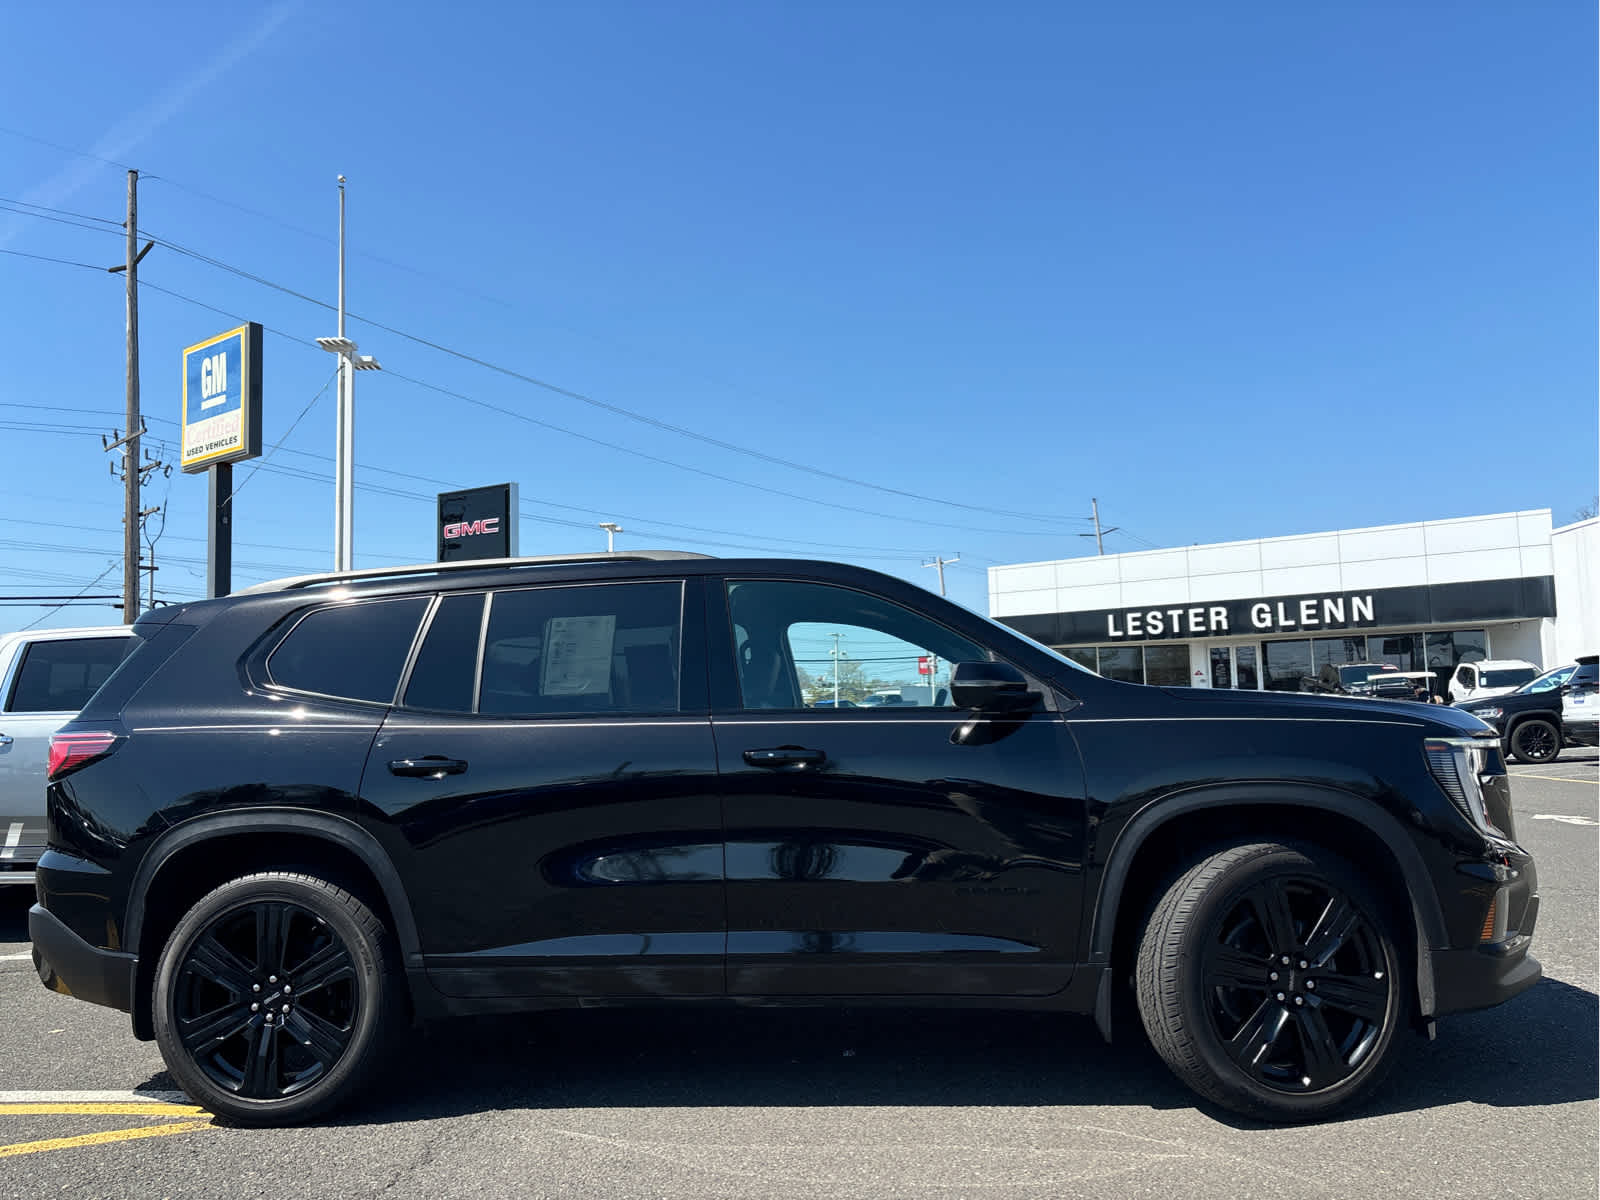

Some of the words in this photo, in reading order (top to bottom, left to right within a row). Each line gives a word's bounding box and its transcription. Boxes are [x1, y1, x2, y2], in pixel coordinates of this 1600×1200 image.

[201, 352, 226, 399] GM
[186, 445, 203, 456] USED
[205, 435, 238, 451] VEHICLES
[444, 517, 499, 539] GMC
[1107, 606, 1229, 637] LESTER
[1250, 595, 1375, 629] GLENN
